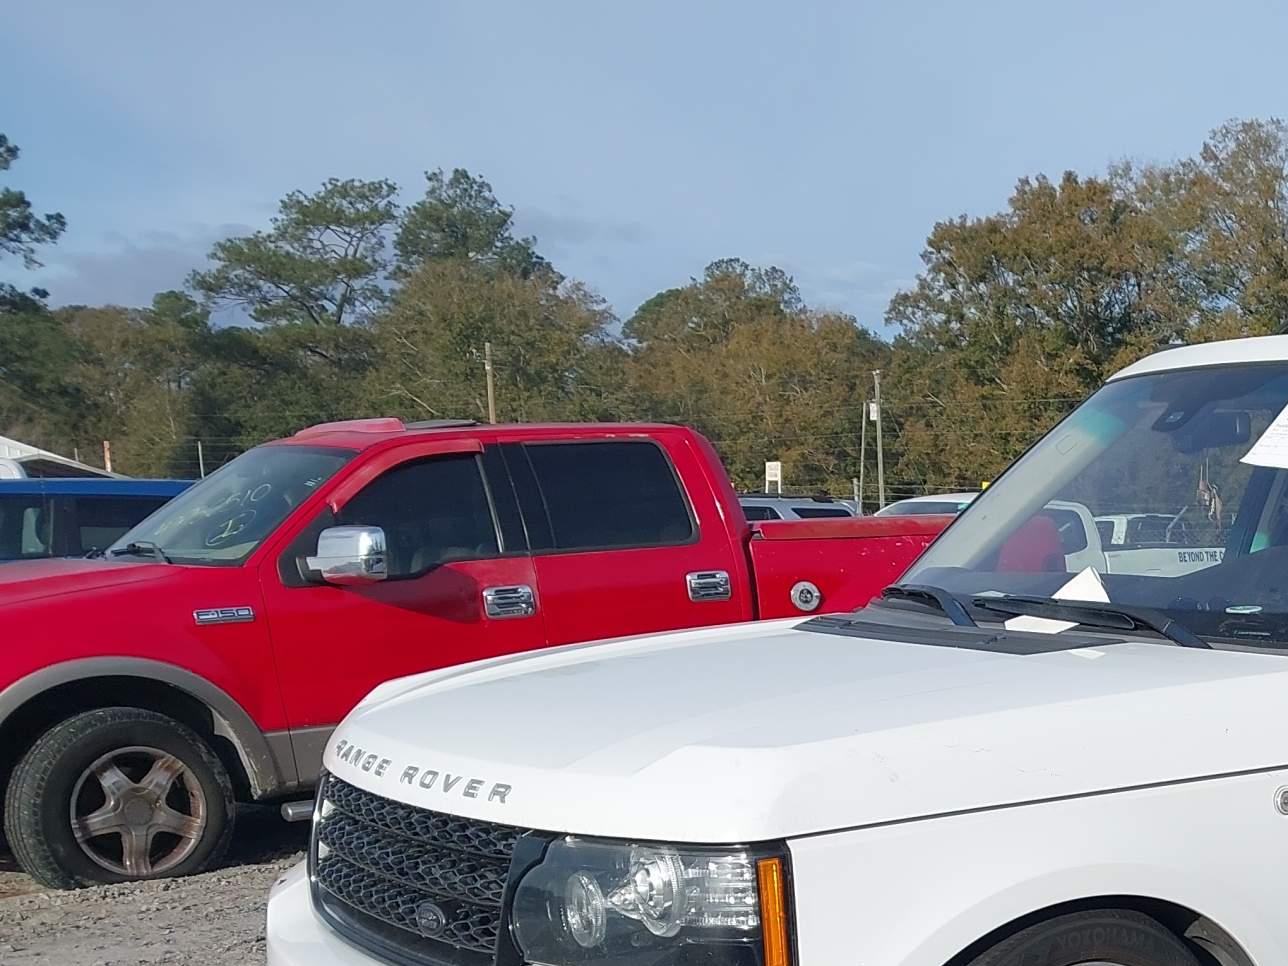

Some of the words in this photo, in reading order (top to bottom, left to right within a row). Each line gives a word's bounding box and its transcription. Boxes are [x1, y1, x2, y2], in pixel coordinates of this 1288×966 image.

[1177, 551, 1204, 562] BEYOND
[1204, 551, 1219, 561] THE
[336, 739, 393, 777] RANGE
[400, 765, 513, 804] ROVER
